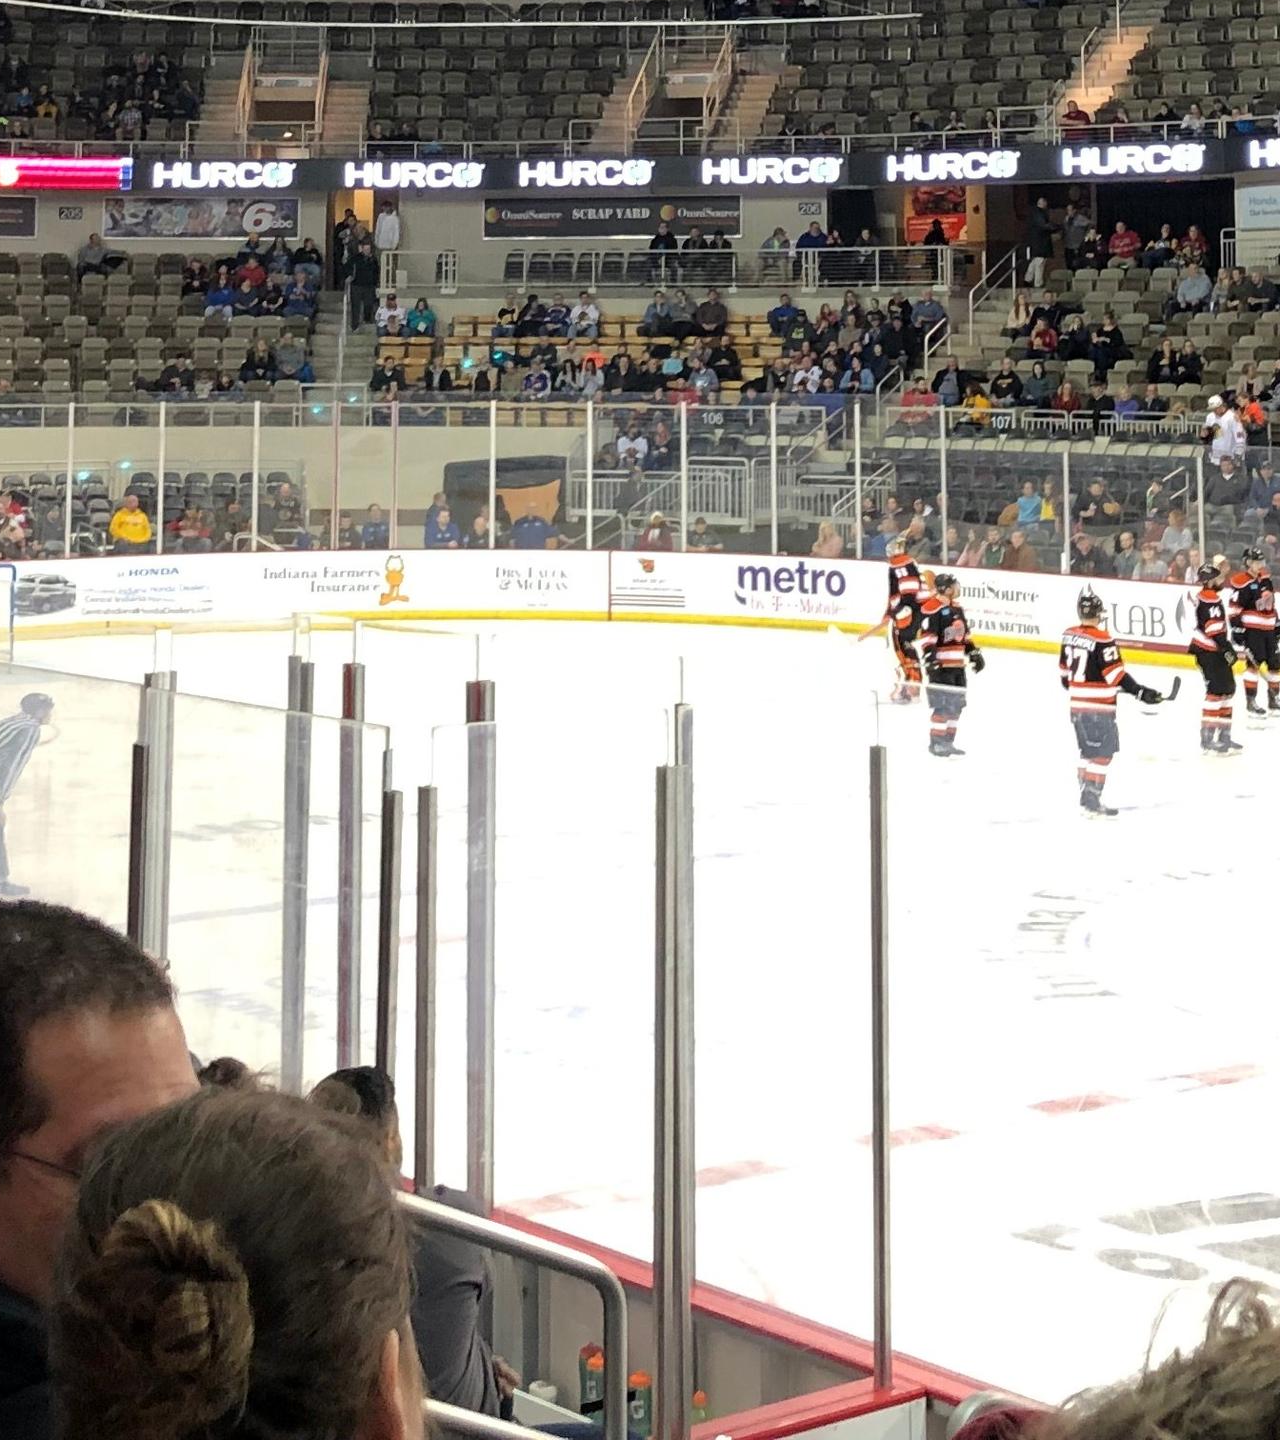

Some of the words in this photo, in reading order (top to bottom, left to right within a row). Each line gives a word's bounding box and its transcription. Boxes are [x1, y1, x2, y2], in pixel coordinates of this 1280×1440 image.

[886, 149, 1021, 183] HURCO
[1061, 142, 1207, 177] HURCO
[151, 161, 296, 189] HURCO
[344, 161, 486, 189] HURCO
[519, 159, 656, 188] HURCO
[701, 156, 844, 185] HURCO
[58, 207, 83, 220] 205
[501, 208, 564, 222] OmniSource
[572, 207, 613, 221] SCRAP
[615, 207, 651, 220] YARD
[676, 206, 741, 220] OmniSource
[799, 203, 821, 215] 206
[242, 201, 277, 234] 6
[701, 412, 724, 425] 106
[990, 415, 1012, 429] 107
[128, 566, 180, 578] HONDA
[263, 566, 319, 580] Indiana
[322, 566, 380, 580] Farmers
[737, 560, 847, 598] metro
[309, 579, 381, 594] Insurance
[977, 618, 997, 632] FAN
[999, 620, 1041, 636] SECTION
